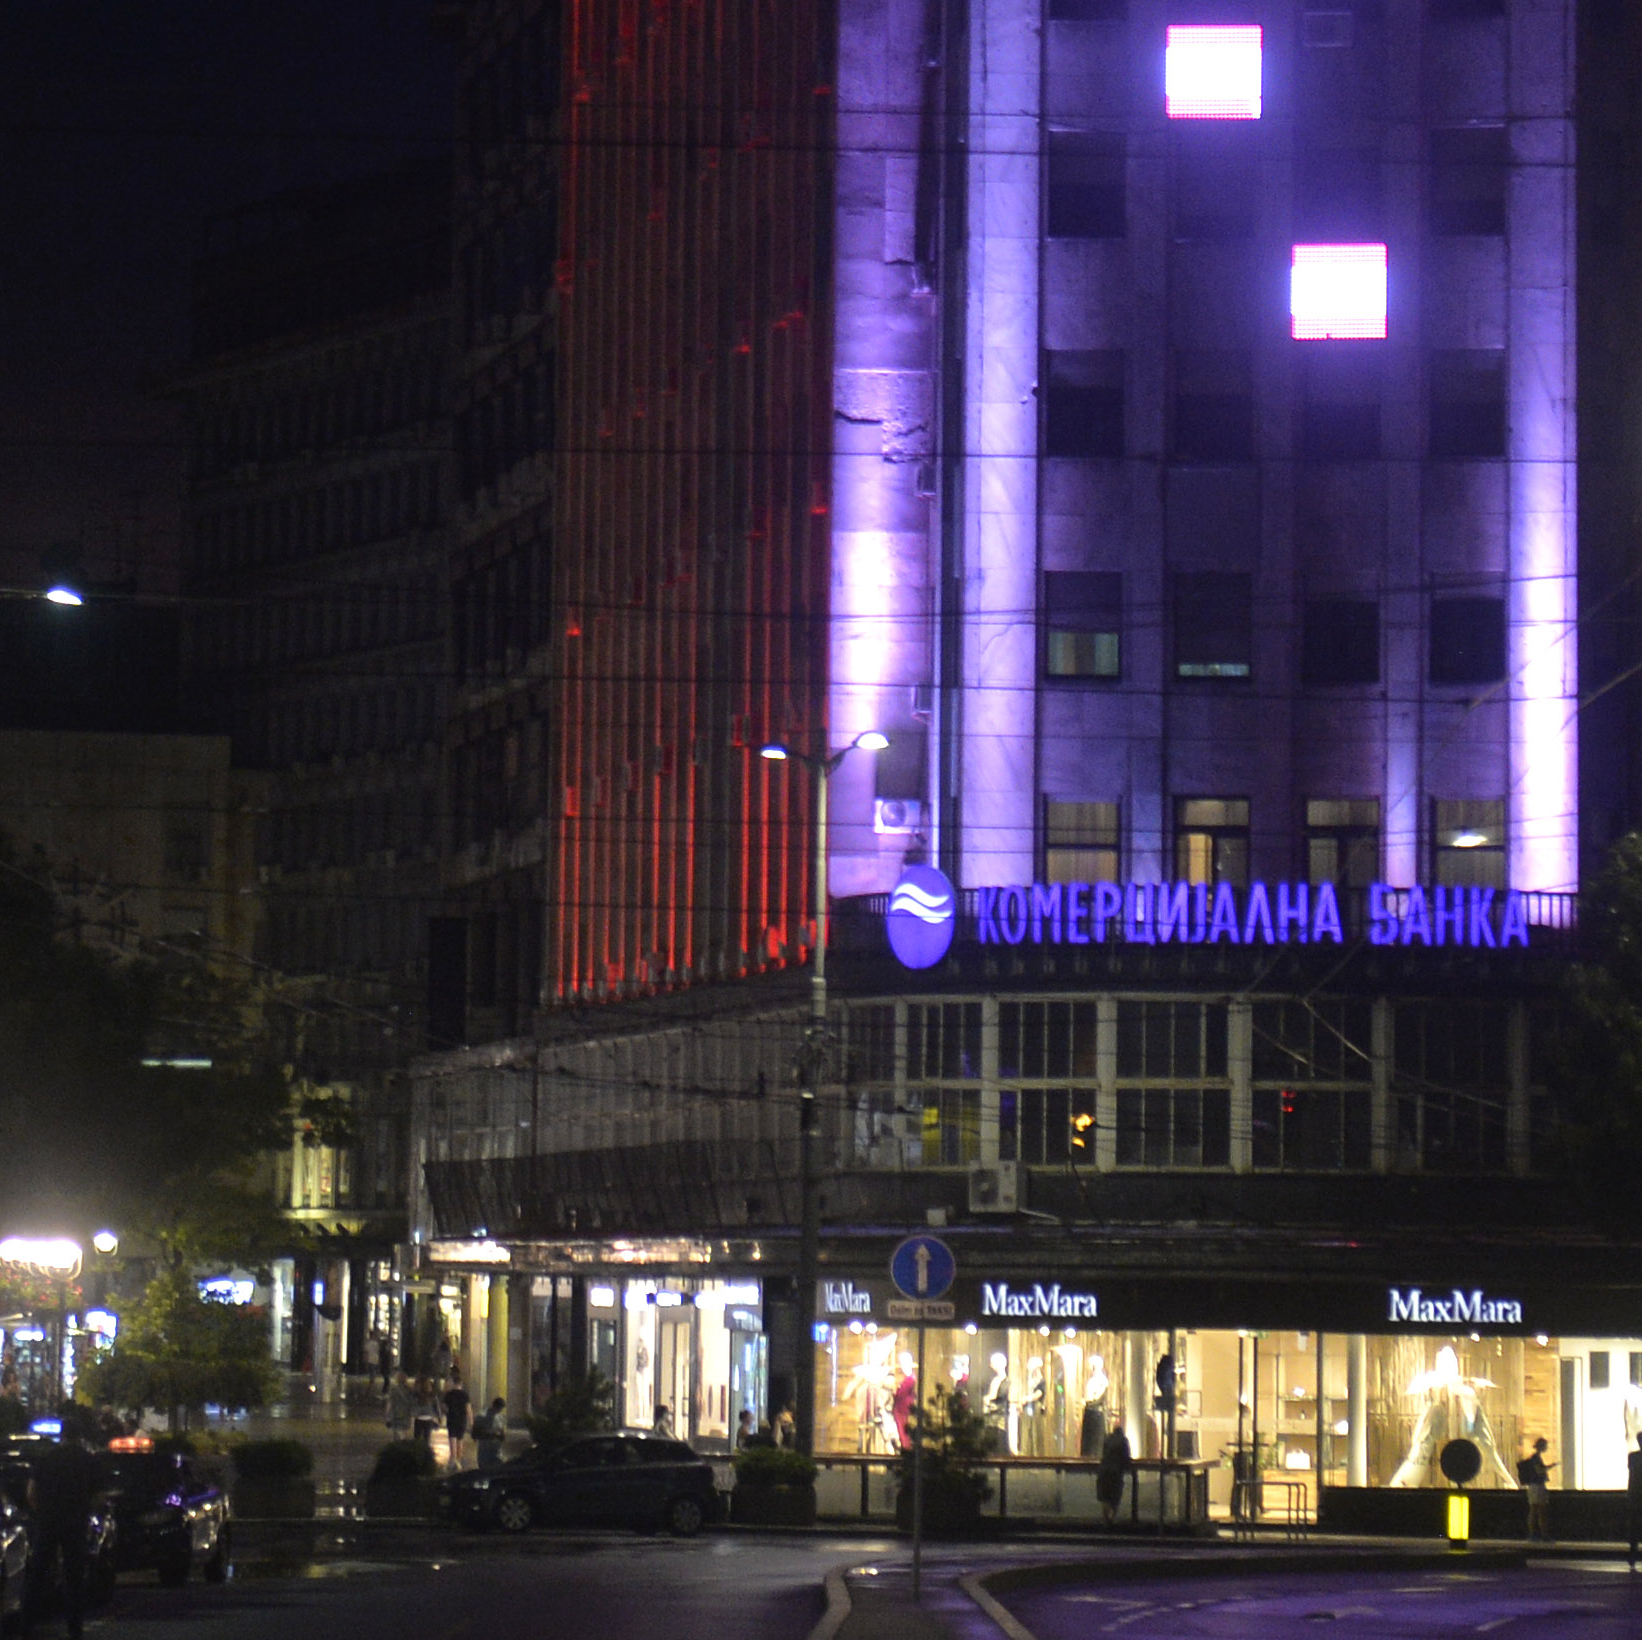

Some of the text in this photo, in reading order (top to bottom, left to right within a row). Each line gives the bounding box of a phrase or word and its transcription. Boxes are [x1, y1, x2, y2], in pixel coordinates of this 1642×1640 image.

[977, 881, 1529, 949] КОМЕРЦИЈАЛНА БАНКА
[823, 1281, 871, 1313] MaxMara
[982, 1282, 1098, 1317] MaxMara
[1387, 1288, 1523, 1324] MaxMara
